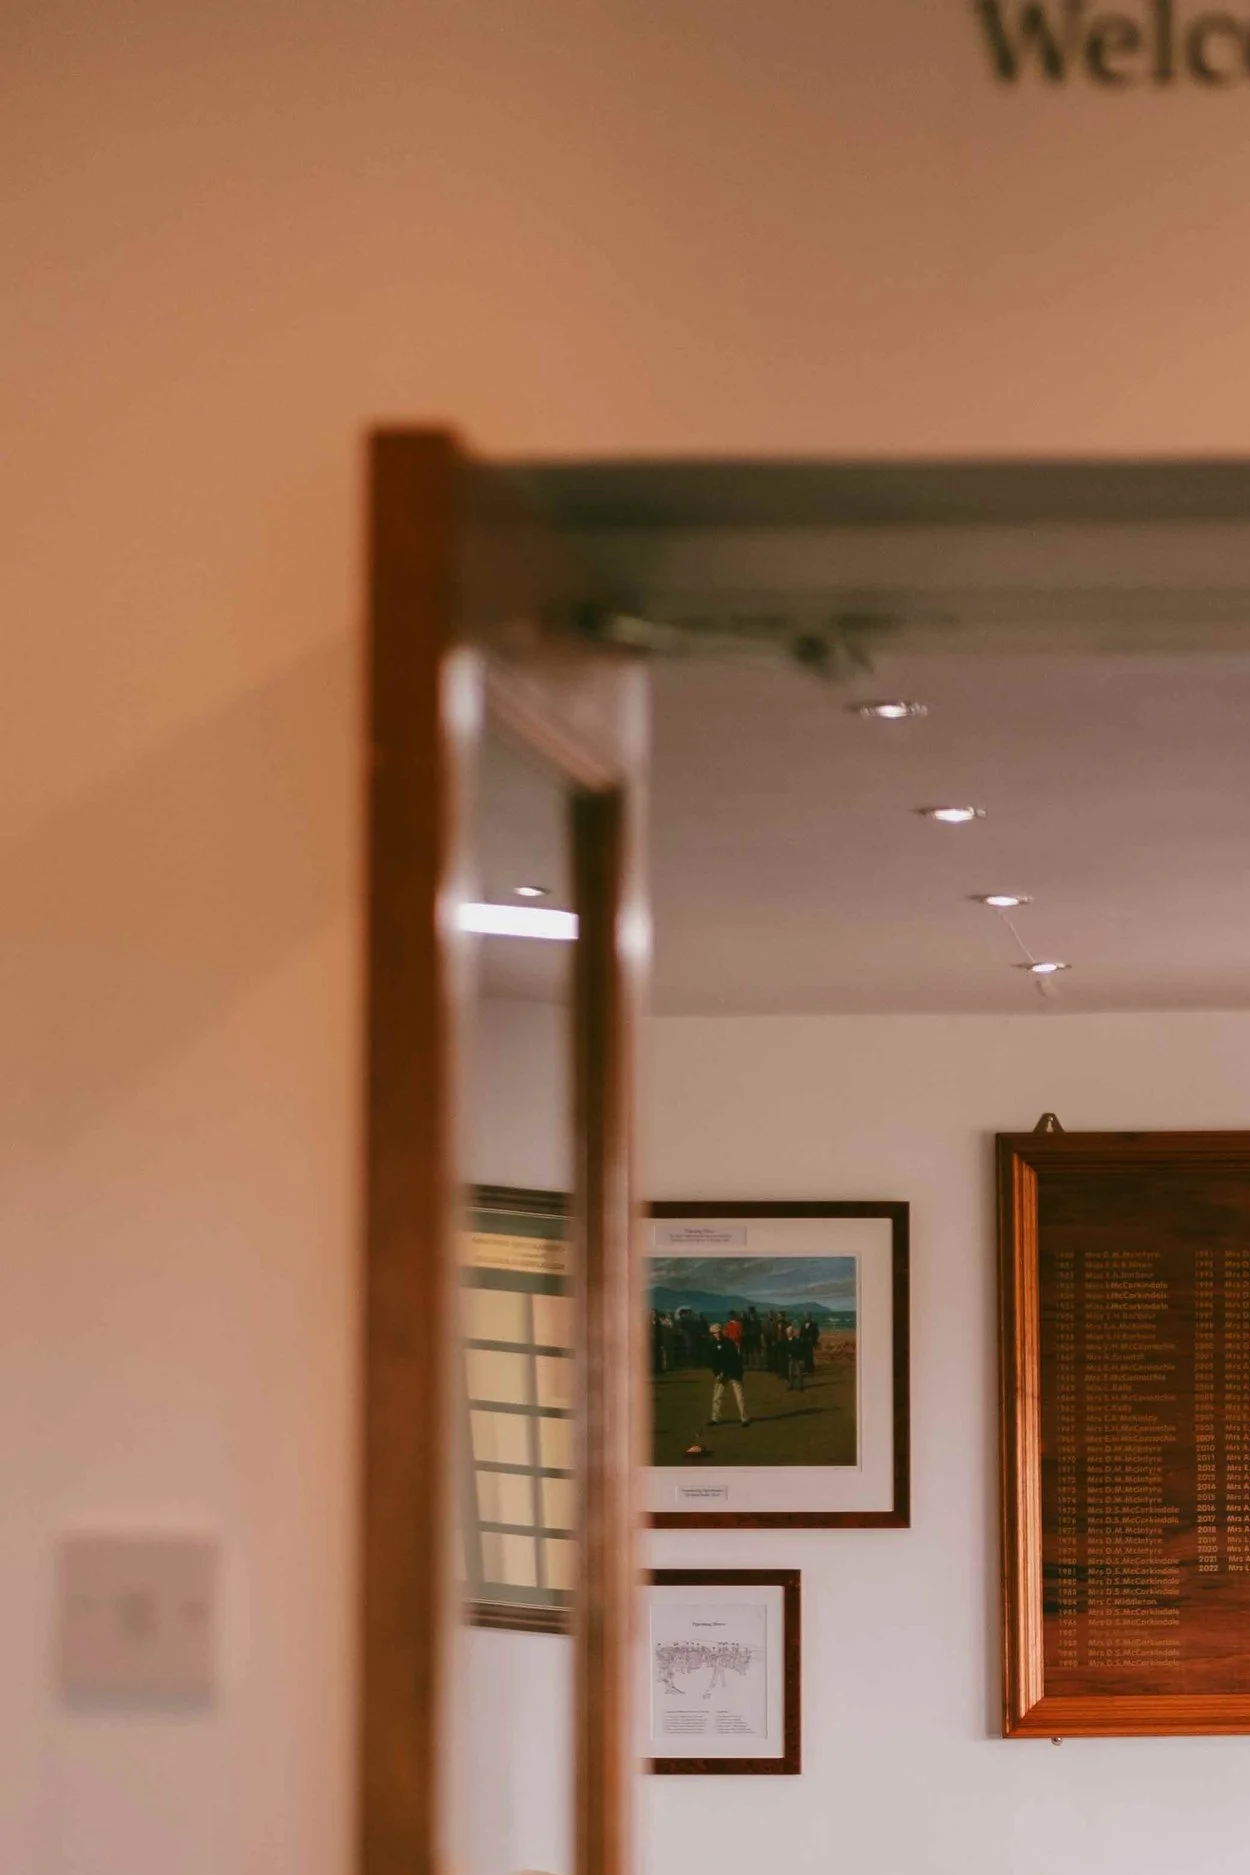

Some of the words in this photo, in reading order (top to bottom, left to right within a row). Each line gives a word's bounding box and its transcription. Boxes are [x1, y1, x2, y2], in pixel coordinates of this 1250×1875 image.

[1197, 1454, 1216, 1462] 2011
[1198, 1474, 1217, 1482] 2013
[1226, 1474, 1241, 1482] Mrs
[1197, 1494, 1216, 1502] 2015
[1226, 1494, 1241, 1502] Mrs
